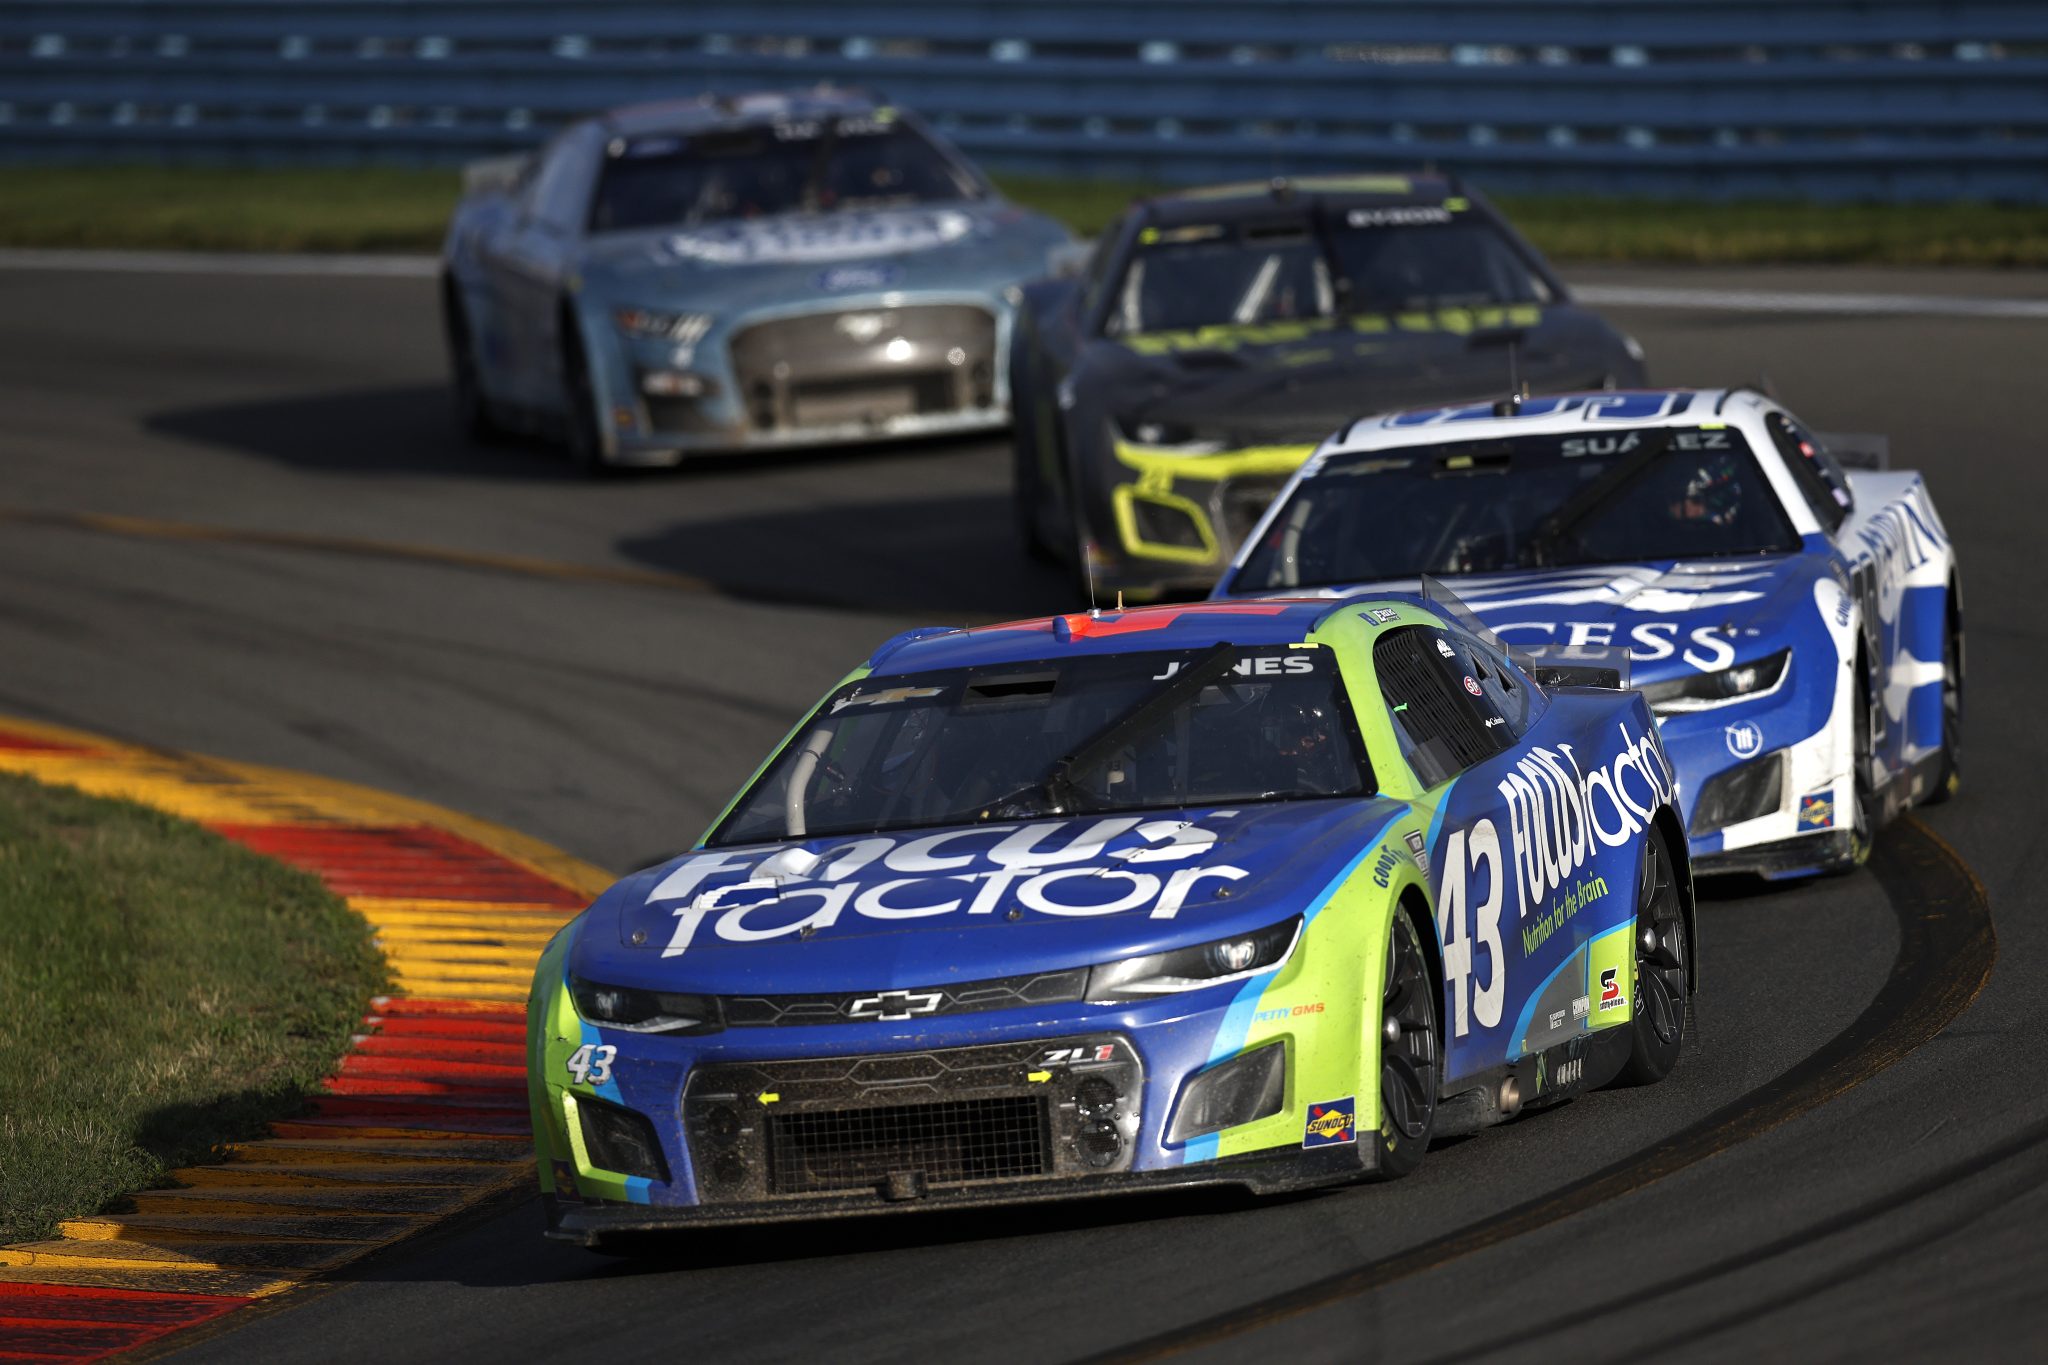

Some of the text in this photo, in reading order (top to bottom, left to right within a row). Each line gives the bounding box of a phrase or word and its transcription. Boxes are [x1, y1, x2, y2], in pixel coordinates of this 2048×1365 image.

[1561, 431, 1731, 457] SUÁEZ
[1152, 656, 1314, 681] JNES
[661, 865, 1250, 958] factor
[1522, 870, 1609, 958] Nutrition for the Brain
[1437, 818, 1506, 1038] 43
[1254, 1003, 1325, 1022] PETTY GMS
[566, 1044, 617, 1085] 43
[1038, 1044, 1114, 1067] ZL1
[1308, 1113, 1354, 1133] SUNOCO
